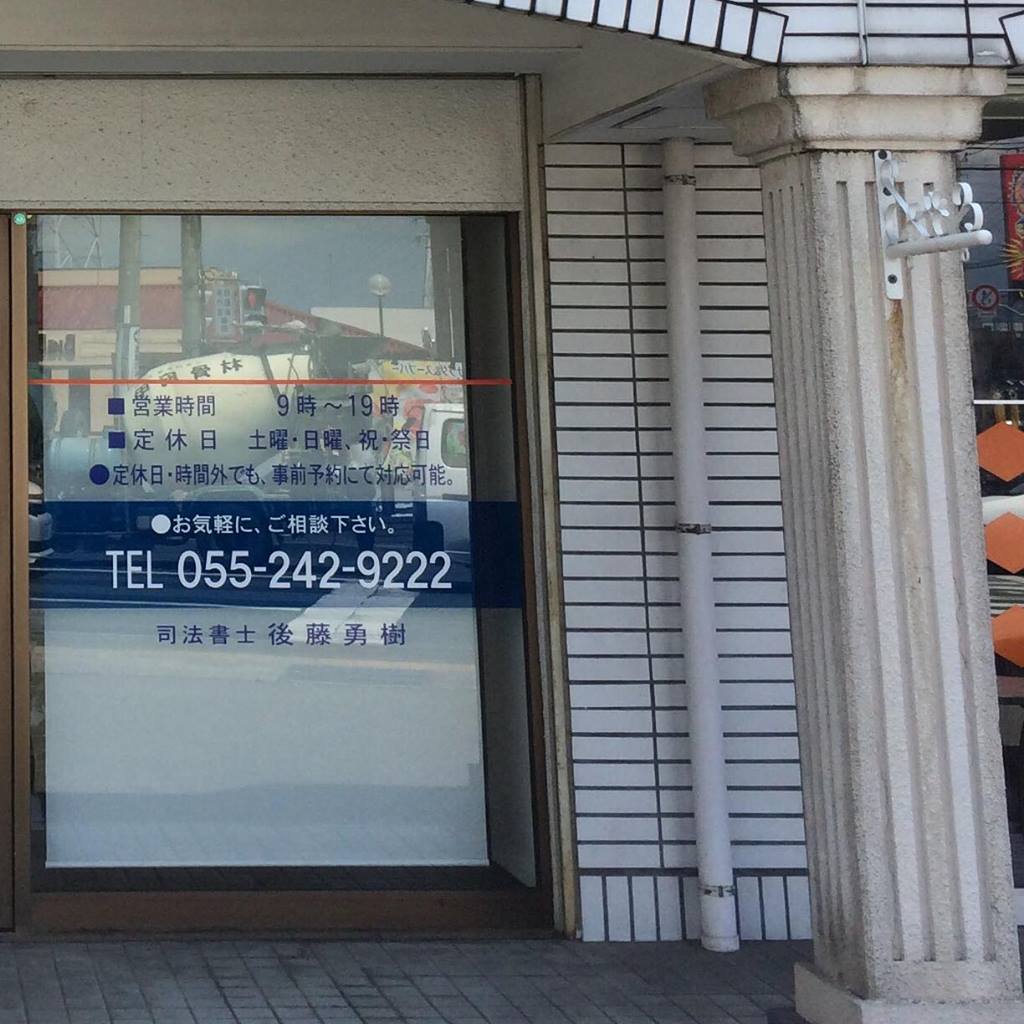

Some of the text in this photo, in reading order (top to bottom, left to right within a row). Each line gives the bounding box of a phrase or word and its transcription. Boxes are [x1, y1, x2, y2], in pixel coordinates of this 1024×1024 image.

[132, 395, 216, 417] 営業時間
[133, 428, 217, 451] 定休日
[105, 550, 453, 590] TEL 055-242-9222
[157, 622, 407, 646] 司法書士 後藤勇樹
